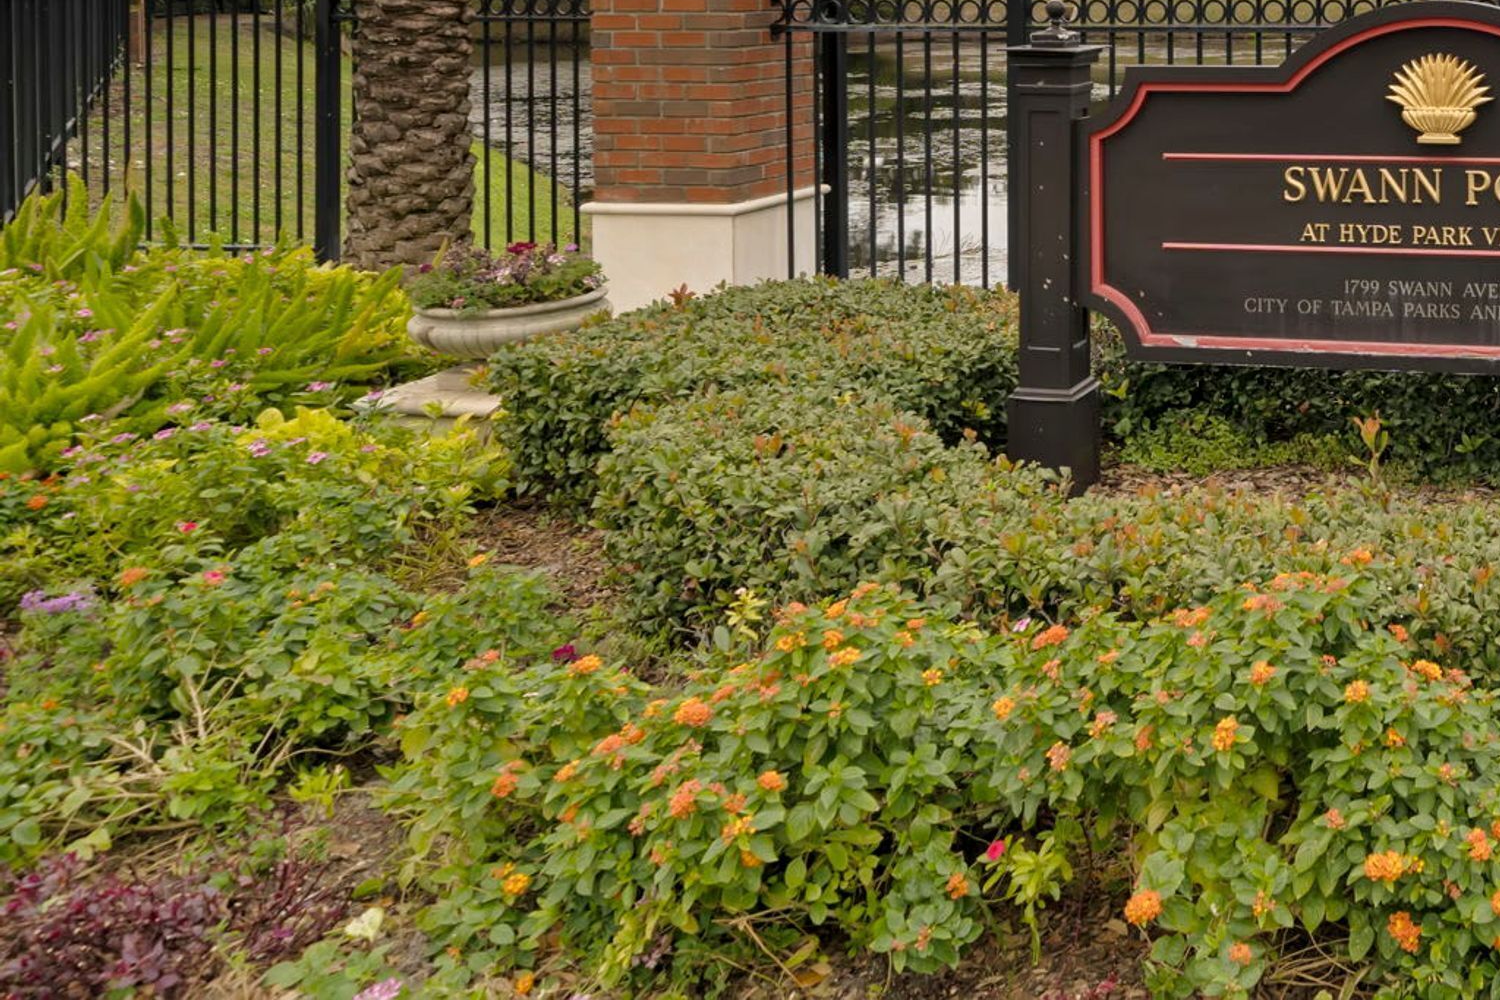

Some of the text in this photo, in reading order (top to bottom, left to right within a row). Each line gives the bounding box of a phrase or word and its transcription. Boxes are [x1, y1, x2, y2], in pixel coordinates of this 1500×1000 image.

[1283, 166, 1442, 203] SWANN
[1300, 223, 1331, 242] AT
[1339, 225, 1403, 245] HYDE
[1413, 226, 1472, 246] PARK
[1344, 279, 1379, 295] 1799
[1388, 279, 1452, 297] SWANN
[1244, 298, 1289, 314] CITY
[1297, 299, 1323, 315] OF
[1332, 300, 1393, 317] TAMPA
[1404, 302, 1460, 319] PARKS
